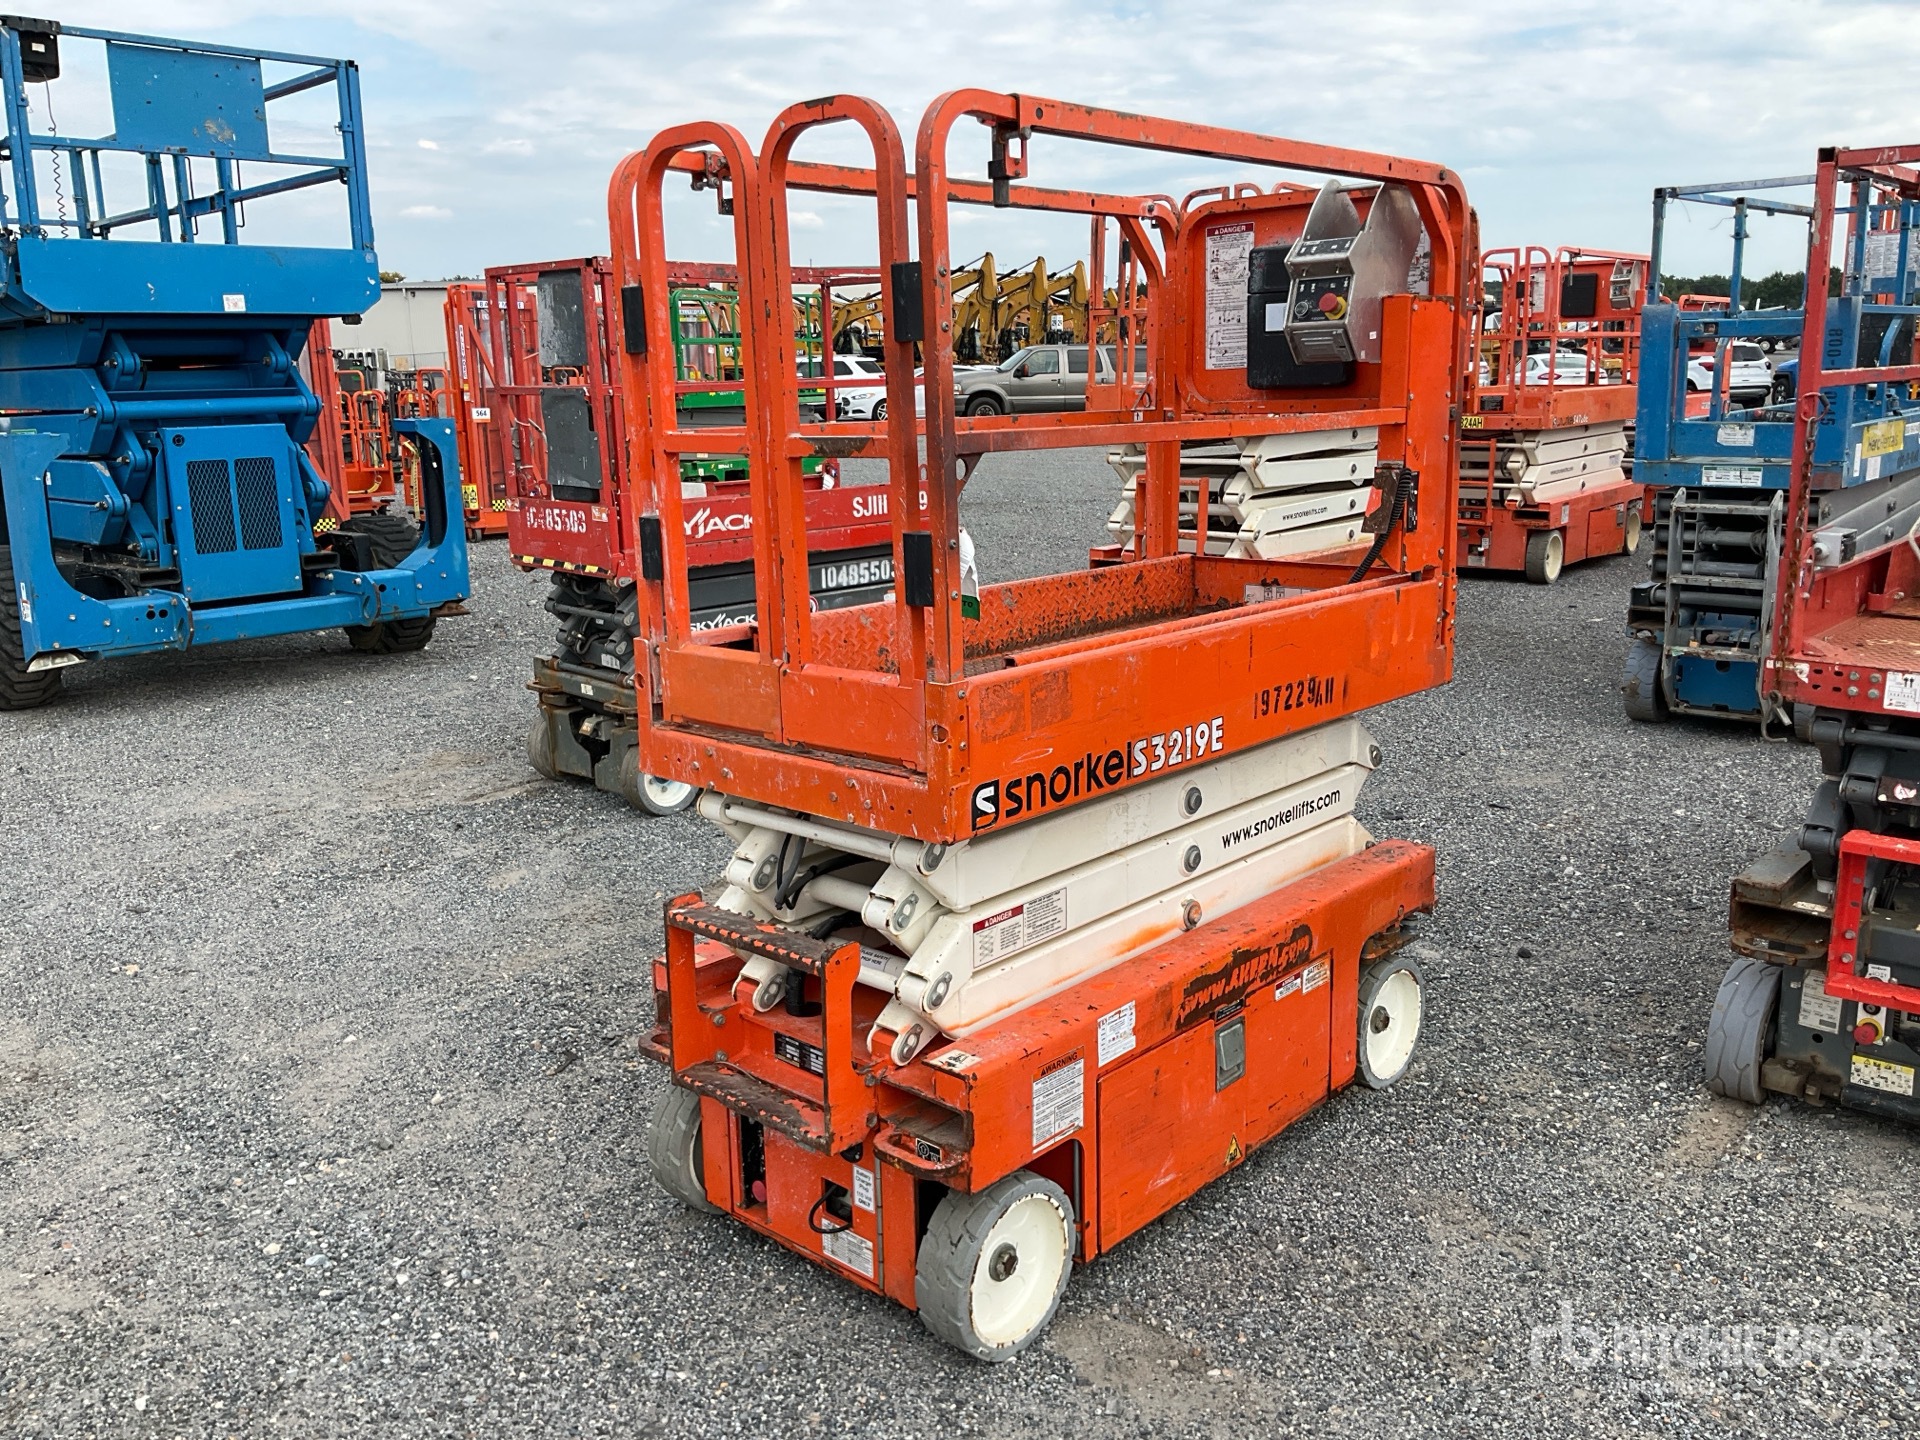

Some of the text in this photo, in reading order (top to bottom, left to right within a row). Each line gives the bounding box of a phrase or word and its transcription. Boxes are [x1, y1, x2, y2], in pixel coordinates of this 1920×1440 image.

[1219, 225, 1246, 234] DANGER
[475, 408, 488, 416] 564
[1131, 716, 1225, 777] S3219E
[1221, 787, 1341, 849] www.snorkellifts.com
[988, 910, 1013, 926] DANGER
[1045, 1051, 1078, 1075] WARNING
